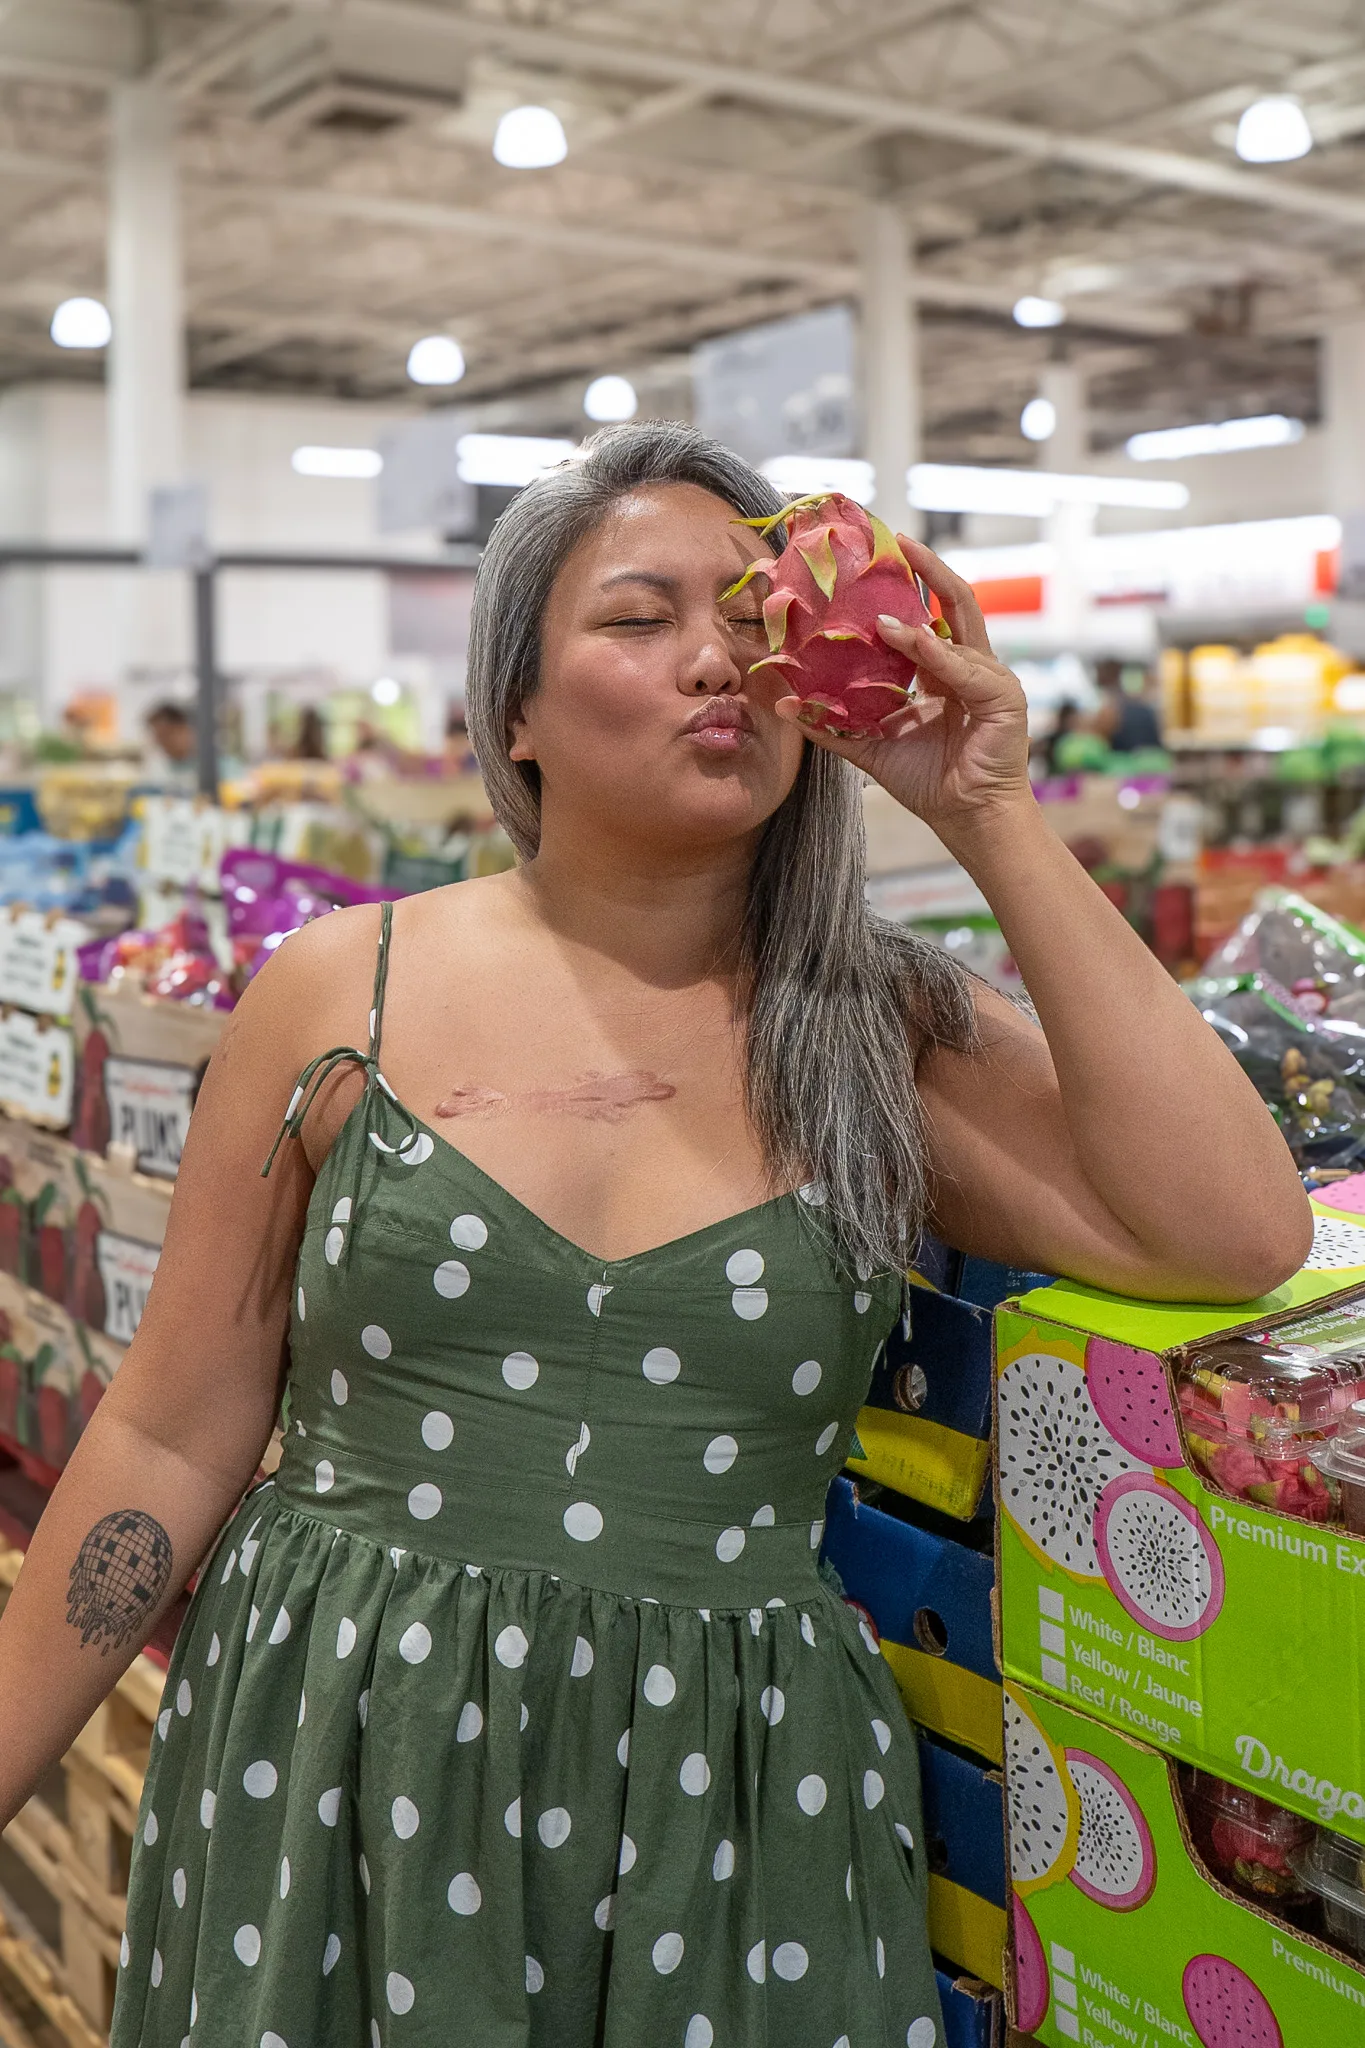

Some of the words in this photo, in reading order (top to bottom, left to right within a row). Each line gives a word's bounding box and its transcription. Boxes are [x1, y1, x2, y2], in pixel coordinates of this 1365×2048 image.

[1210, 1505, 1328, 1565] Premium
[1069, 1604, 1124, 1647] White
[1126, 1632, 1135, 1651] /
[1137, 1635, 1190, 1677] Blanc
[1070, 1674, 1105, 1709] Red
[1109, 1694, 1116, 1712] /
[1119, 1697, 1182, 1744] Rouge
[1071, 1639, 1130, 1684] Yellow
[1132, 1670, 1141, 1690] /
[1143, 1674, 1203, 1718] Jaune
[1080, 1963, 1131, 2010] White
[1134, 1998, 1141, 2015] /
[1143, 2001, 1193, 2048] Blanc
[1272, 1938, 1365, 2008] Premium
[1082, 1995, 1138, 2045] Yellow
